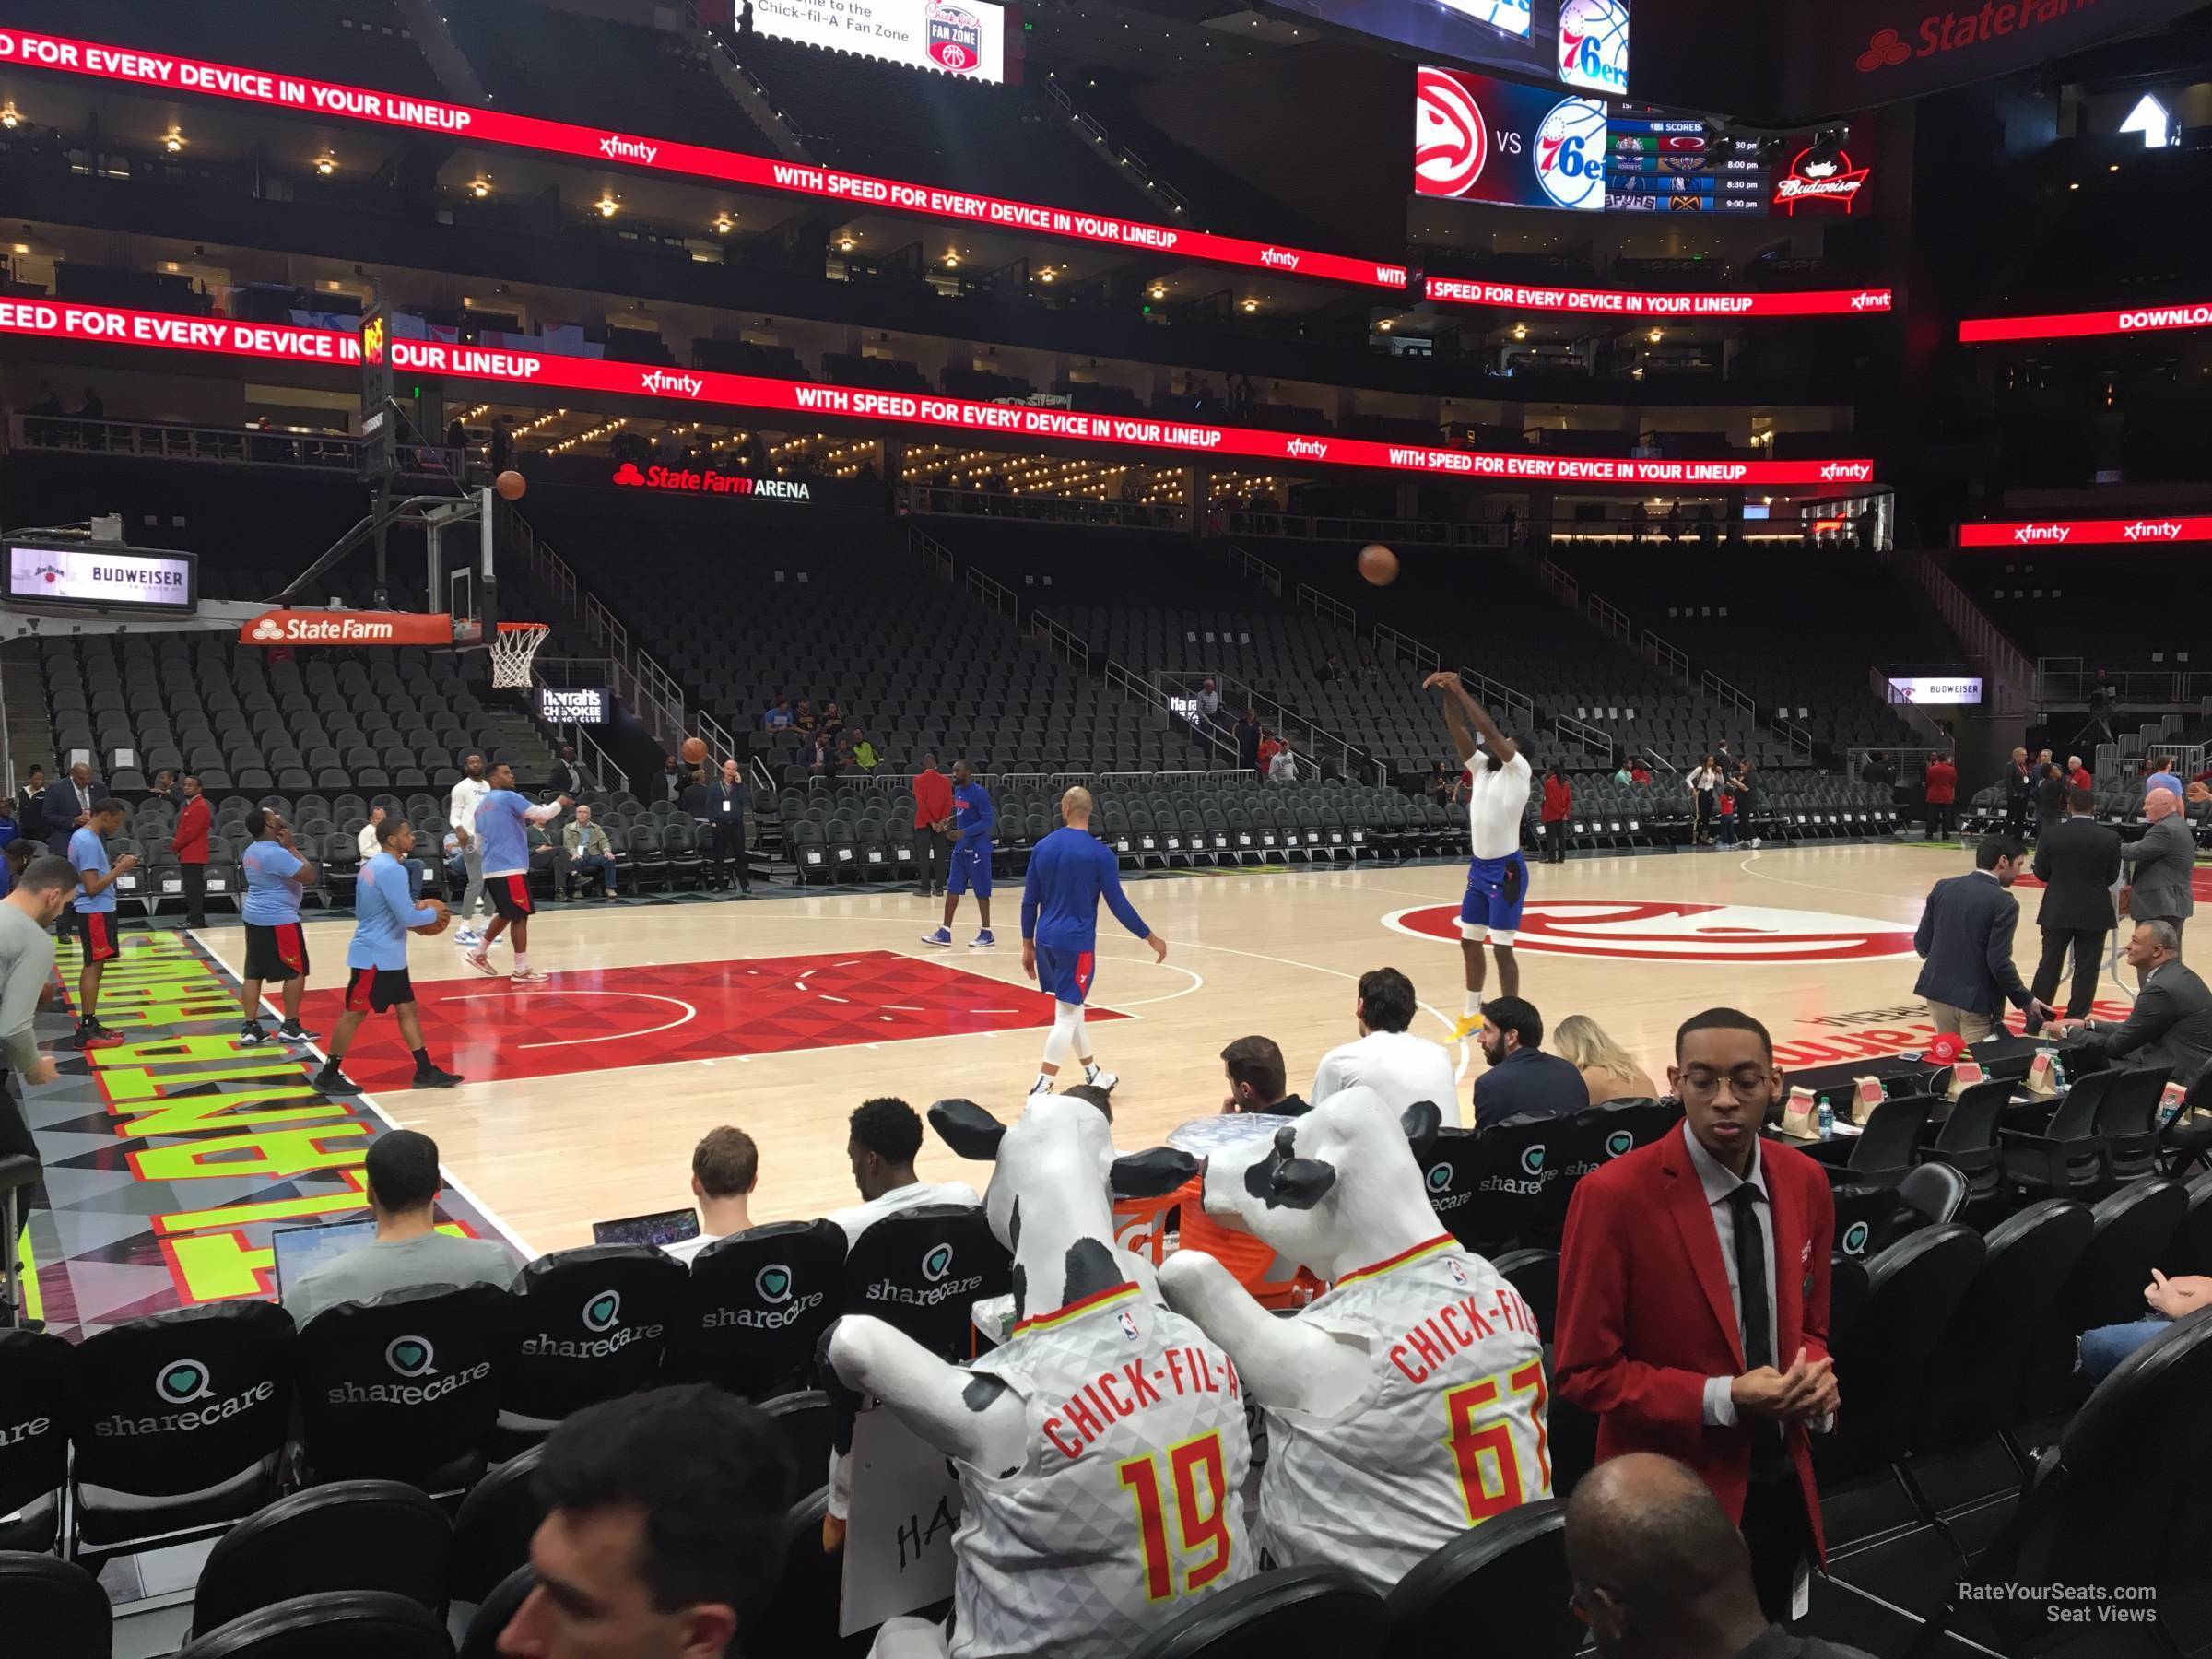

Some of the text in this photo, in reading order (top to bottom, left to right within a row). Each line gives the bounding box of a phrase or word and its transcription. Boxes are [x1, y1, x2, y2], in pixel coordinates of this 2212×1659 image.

[849, 3, 872, 17] the
[847, 18, 871, 33] Fan
[875, 24, 909, 41] Zone
[932, 24, 976, 45] FAN ZONE
[1915, 2, 2016, 58] State
[22, 39, 79, 66] FOR
[87, 49, 173, 81] EVERY
[180, 65, 273, 99] DEVICE
[279, 81, 305, 103] IN
[312, 87, 381, 115] YOUR
[387, 100, 471, 130] LINEUP
[599, 135, 657, 164] xfinity
[1496, 130, 1522, 154] VS
[1727, 160, 1745, 169] 8:00
[1727, 181, 1758, 191] 8:30 pm
[1778, 179, 1862, 196] Budweiser
[773, 166, 1178, 248] WITH SPEED FOR EVERY DEVICE IN YOUR LINEUP
[1745, 201, 1758, 209] pm
[1260, 247, 1300, 270] xfinity
[1435, 282, 1482, 300] SPEED
[1486, 287, 1513, 303] FOR
[1517, 289, 1565, 306] EVERY
[1569, 292, 1622, 310] DEVICE
[1627, 296, 1641, 311] IN
[1646, 297, 1691, 312] YOUR
[1695, 297, 1753, 312] LINEUP
[1851, 292, 1891, 310] xfinit
[0, 303, 58, 329] EED
[65, 310, 127, 336] FOR
[135, 317, 228, 346] EVERY
[235, 327, 332, 358] DEVICE
[339, 338, 360, 359] IN
[392, 344, 446, 370] OUR
[453, 350, 541, 378] LINEUP
[641, 370, 703, 397] xfinity
[795, 387, 848, 410] WITH
[853, 394, 916, 417] SPEED
[921, 400, 959, 421] FOR
[963, 406, 1022, 428] EVERY
[1027, 412, 1088, 435] DEVICE
[1092, 418, 1110, 437] IN
[1113, 421, 1160, 441] YOUR
[1164, 427, 1222, 447] LINEUP
[1286, 437, 1328, 459] xfinity
[1389, 449, 1747, 480] WITH SPEED FOR EVERY DEVICE IN YOUR LINEUP
[1820, 462, 1870, 481] xfinity
[754, 479, 810, 499] ARENA
[2014, 524, 2071, 543] xfinity
[2124, 521, 2183, 542] xfinity
[93, 567, 182, 586] BUDWEISER
[1930, 685, 1979, 694] BUDWEISER
[543, 706, 602, 717] CHOKEE
[1793, 1005, 1931, 1027] RENA
[866, 1272, 982, 1306] sharecare
[702, 1289, 824, 1330] sharecare
[522, 1321, 663, 1359] sharecare
[328, 1360, 491, 1406] sharecare
[95, 1380, 275, 1438] sharecare
[1117, 1428, 1231, 1606] 19
